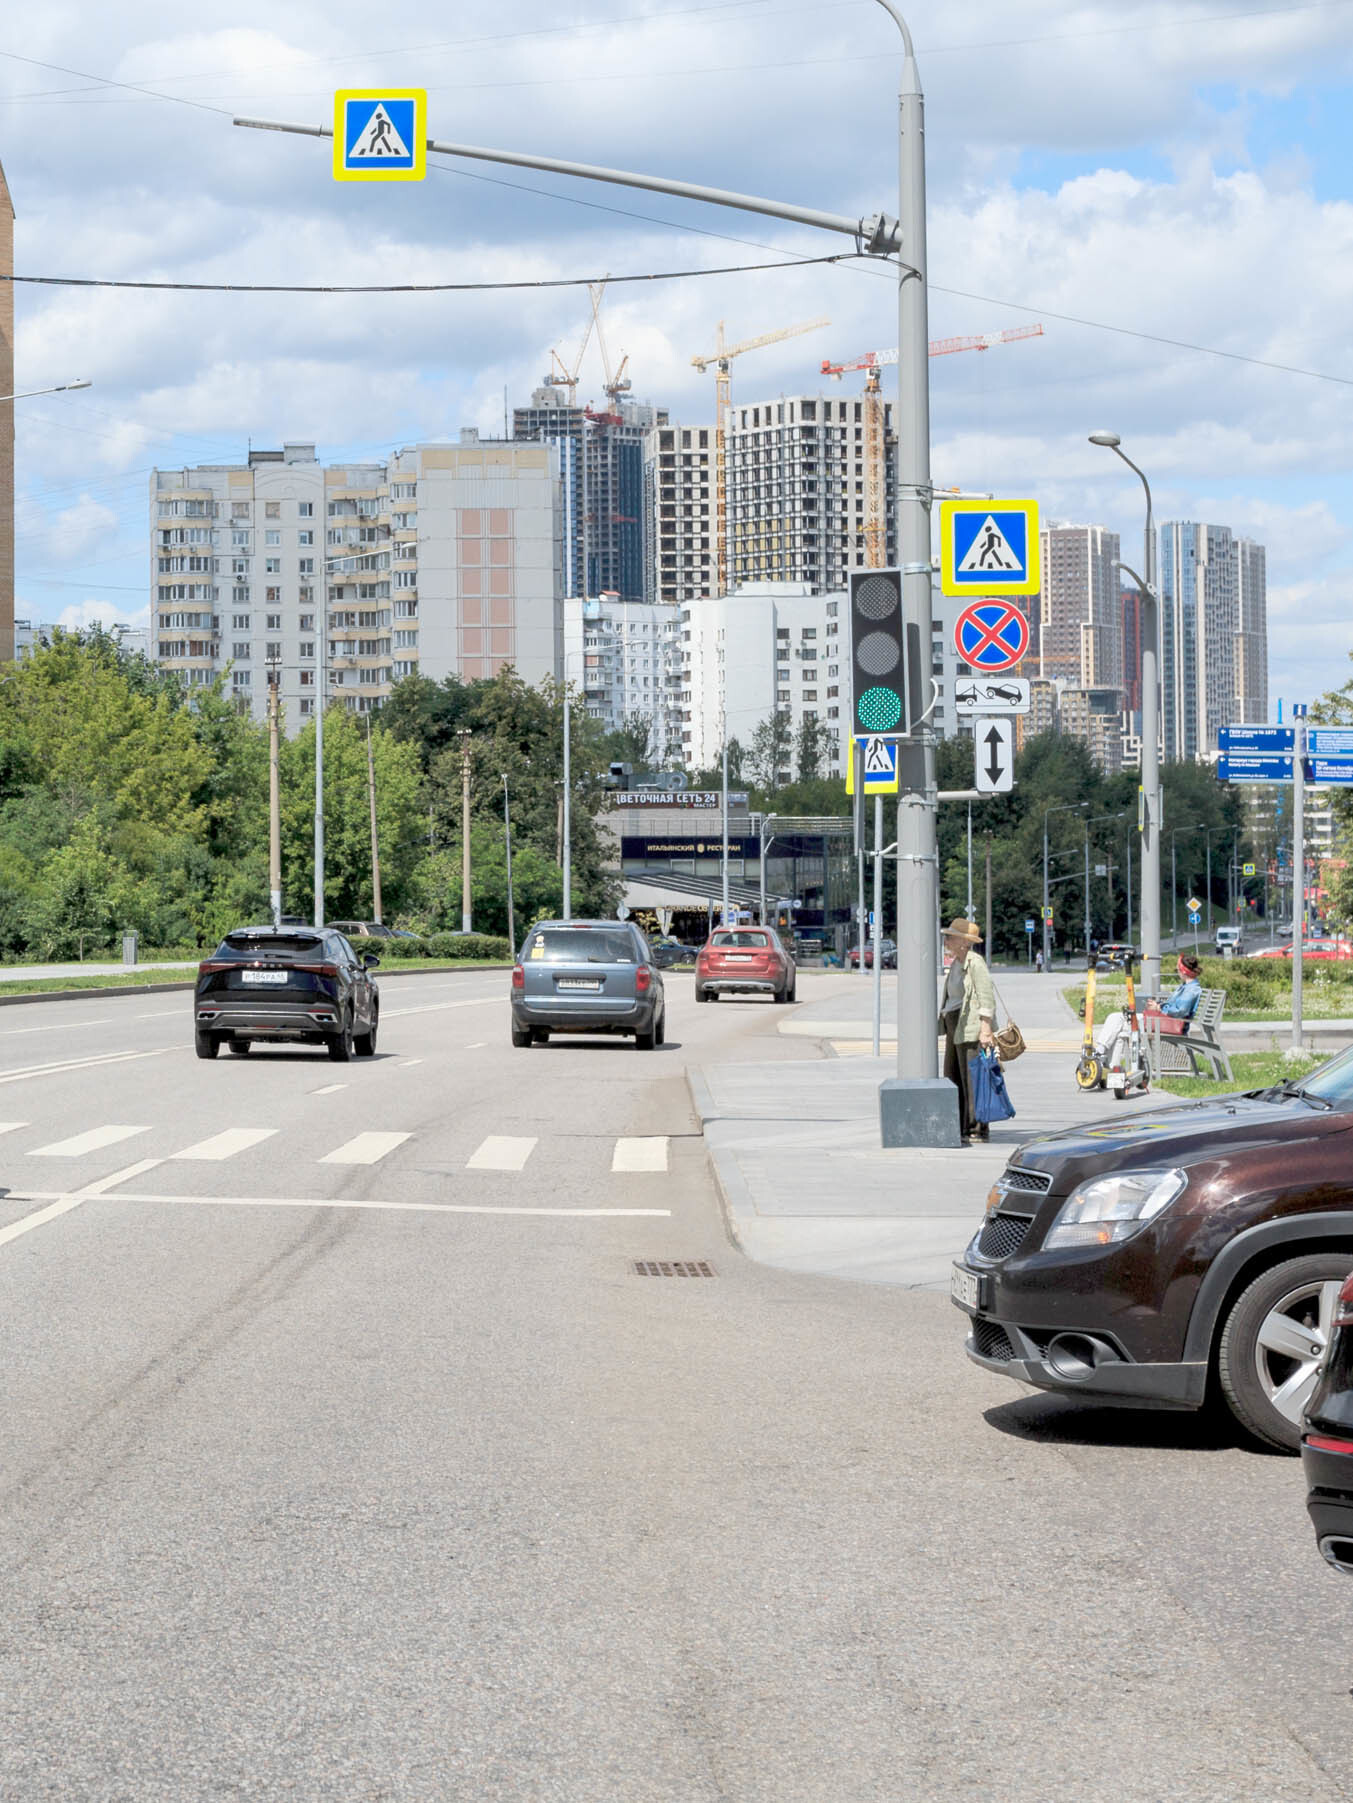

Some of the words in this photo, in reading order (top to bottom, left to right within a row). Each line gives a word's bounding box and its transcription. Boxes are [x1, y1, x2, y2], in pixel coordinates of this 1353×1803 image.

[677, 794, 703, 804] СЕТЬ
[704, 793, 716, 802] 24
[706, 844, 741, 852] РЕСТРАН
